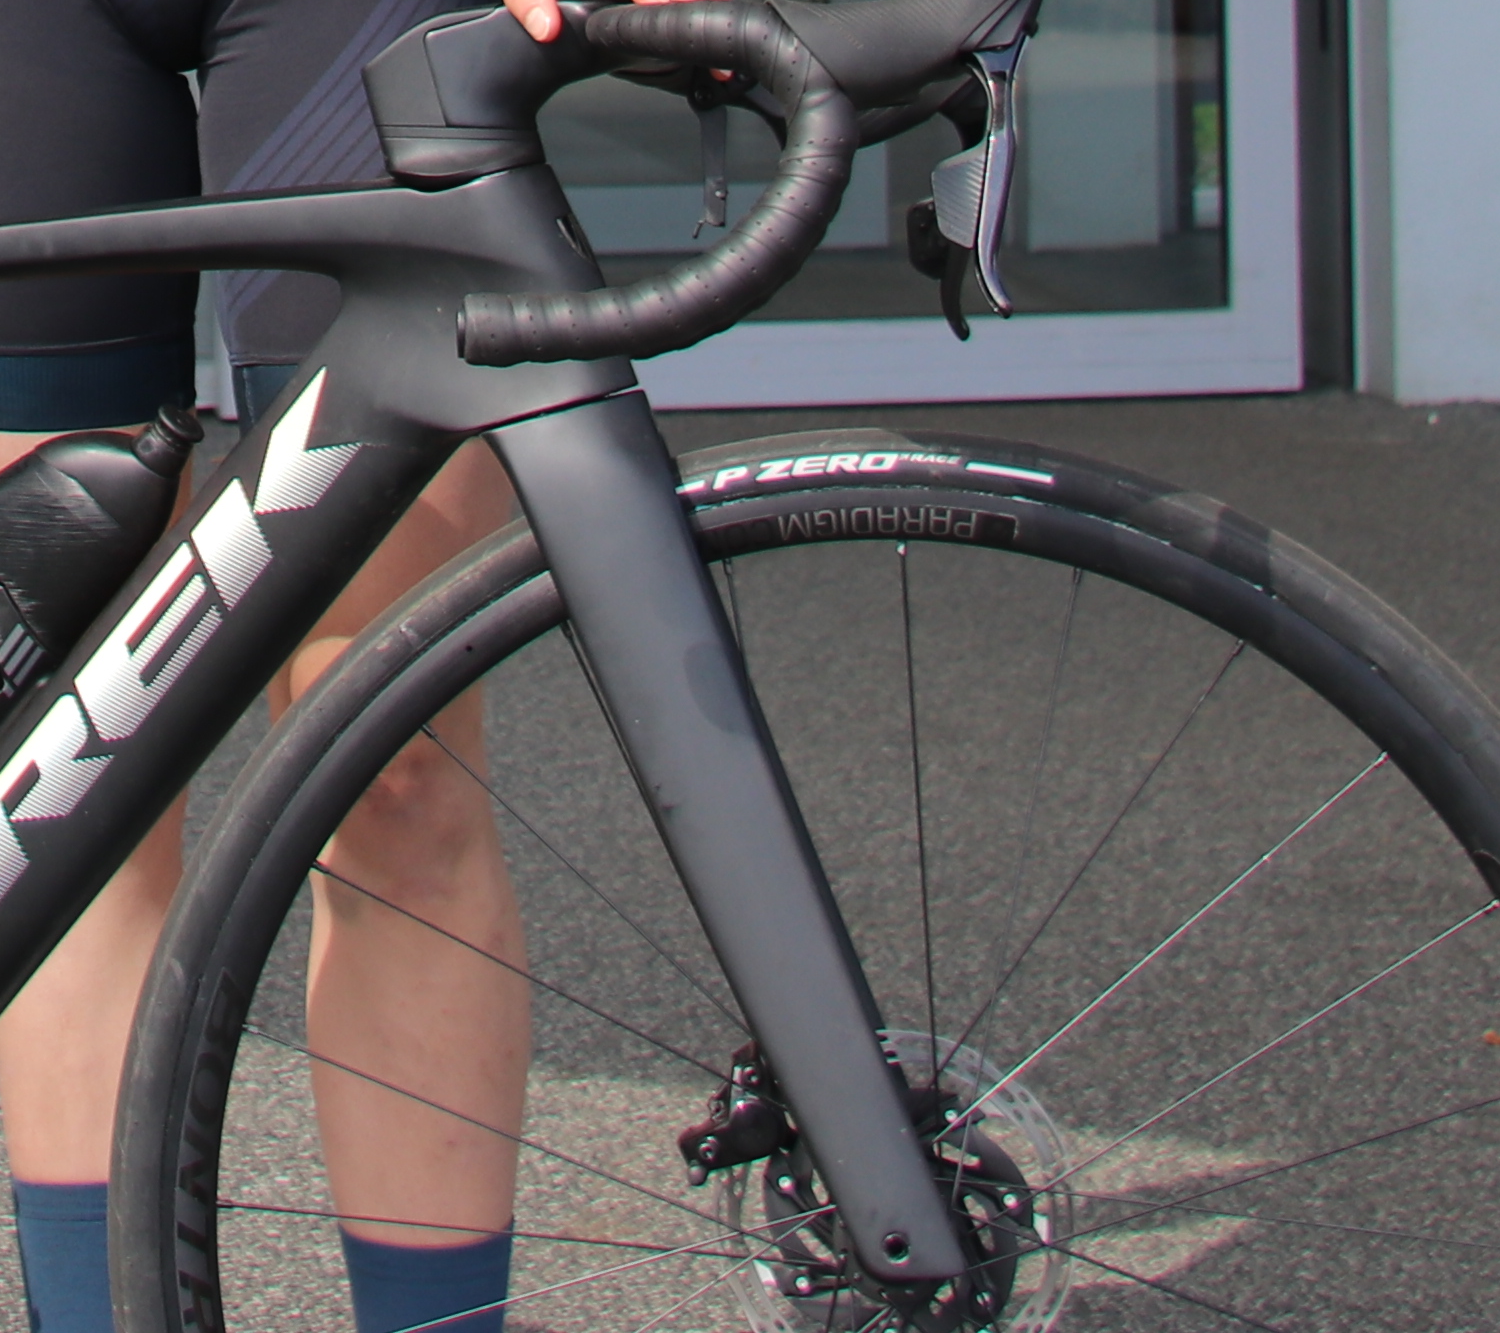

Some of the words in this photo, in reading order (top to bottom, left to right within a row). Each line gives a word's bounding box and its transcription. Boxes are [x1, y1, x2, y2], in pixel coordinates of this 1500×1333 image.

[711, 464, 750, 491] P
[754, 450, 900, 484] ZERO
[777, 505, 978, 540] PARADIGM
[175, 968, 247, 1333] BONTR
